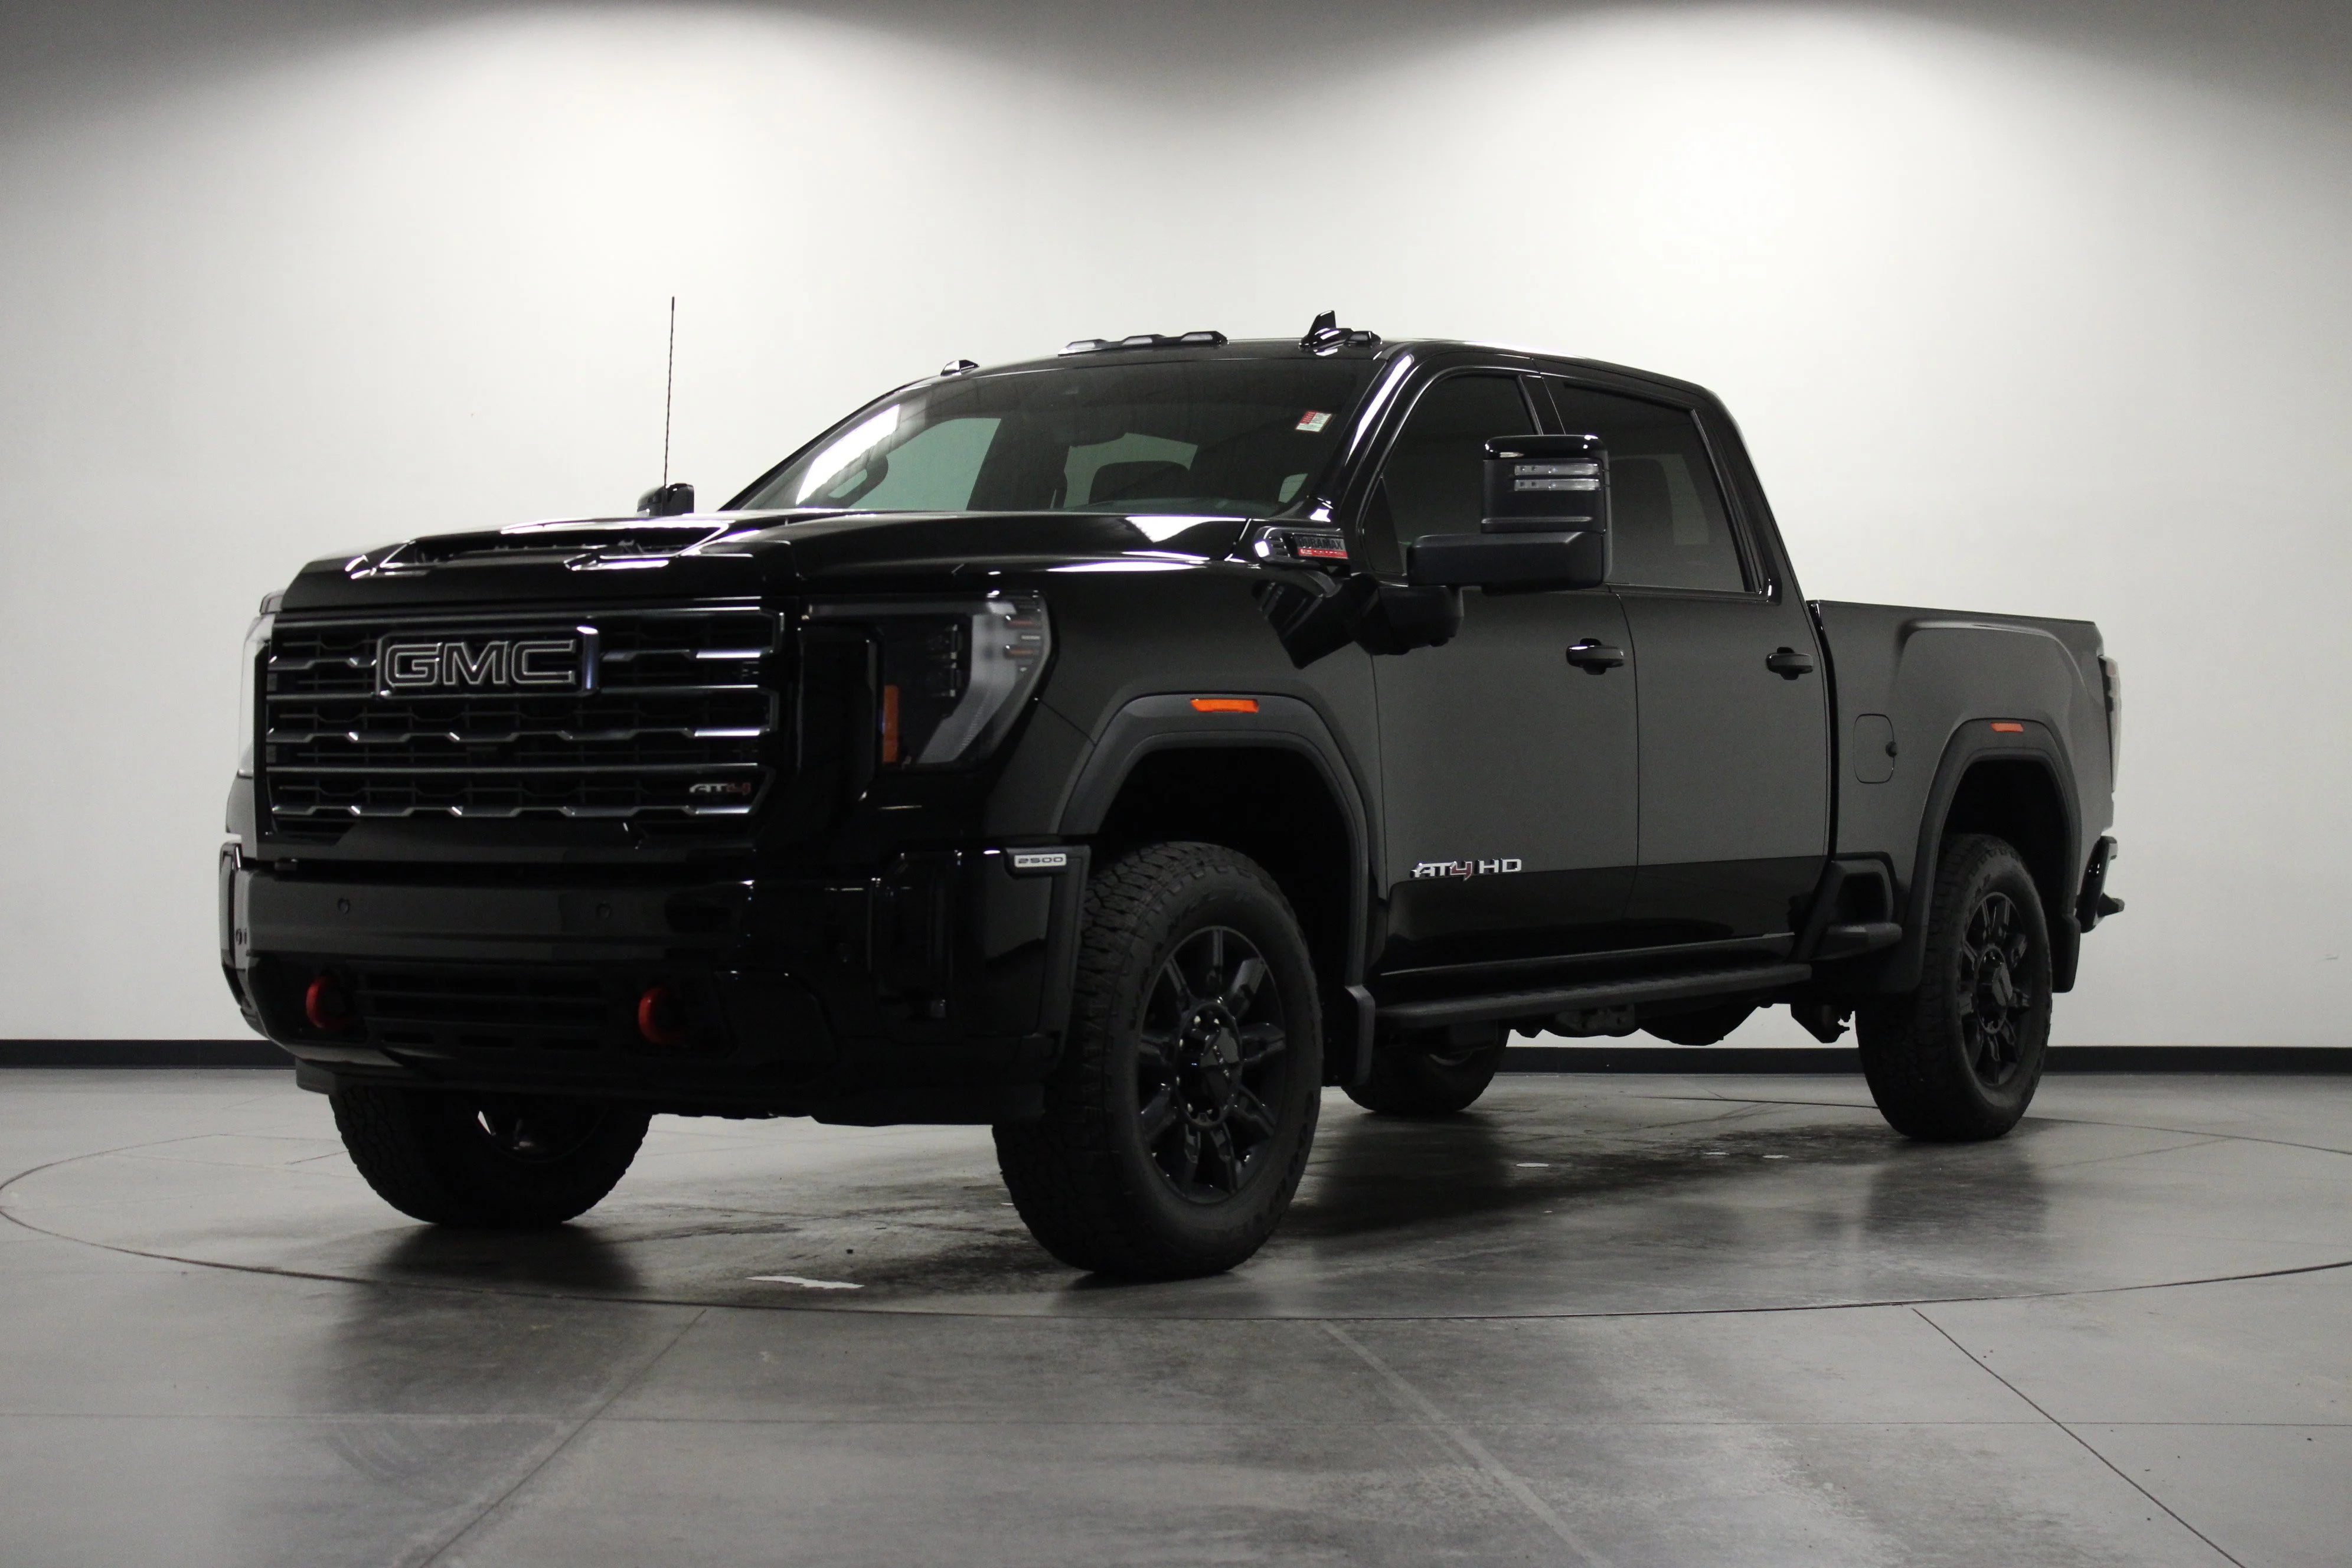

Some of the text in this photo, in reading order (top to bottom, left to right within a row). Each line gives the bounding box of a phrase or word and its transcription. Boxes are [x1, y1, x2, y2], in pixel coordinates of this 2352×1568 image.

[1298, 537, 1343, 550] DURAMAX
[385, 639, 577, 687] GMC
[689, 782, 752, 796] AT4
[1410, 858, 1522, 881] AT4 HD
